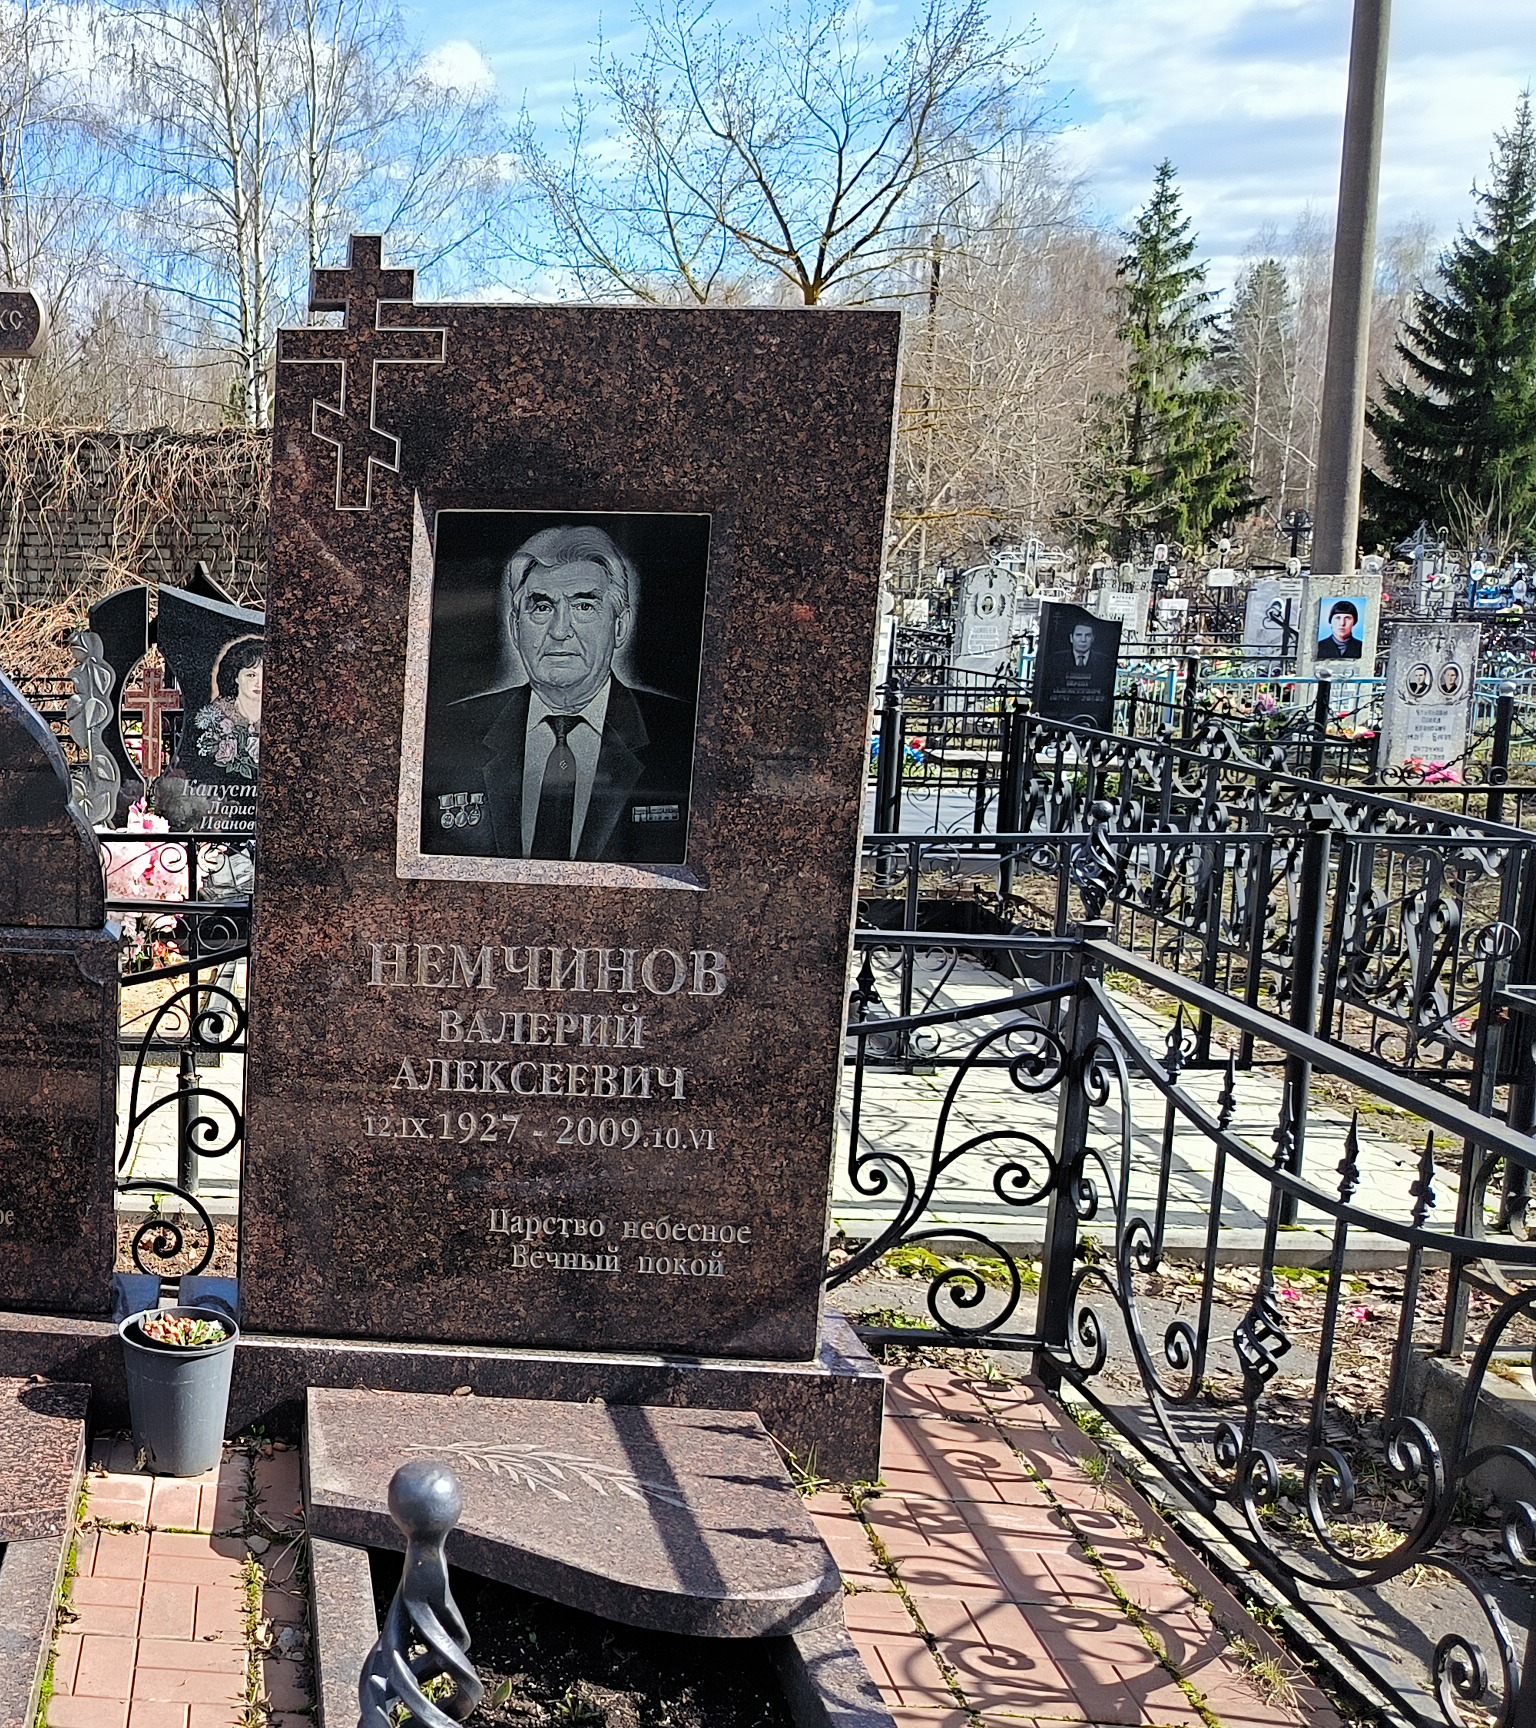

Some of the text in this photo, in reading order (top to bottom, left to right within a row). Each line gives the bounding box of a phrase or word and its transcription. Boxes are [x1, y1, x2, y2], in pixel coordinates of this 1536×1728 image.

[200, 816, 256, 830] Иванов
[207, 801, 256, 818] Ларис
[366, 941, 728, 996] НЕМЧИНОВ
[437, 1004, 646, 1050] ВАЛЕРИЙ
[391, 1056, 687, 1100] АЛЕКСЕЕВИЧ
[489, 1208, 752, 1245] Царство небесное
[510, 1244, 727, 1277] Вечный покой
